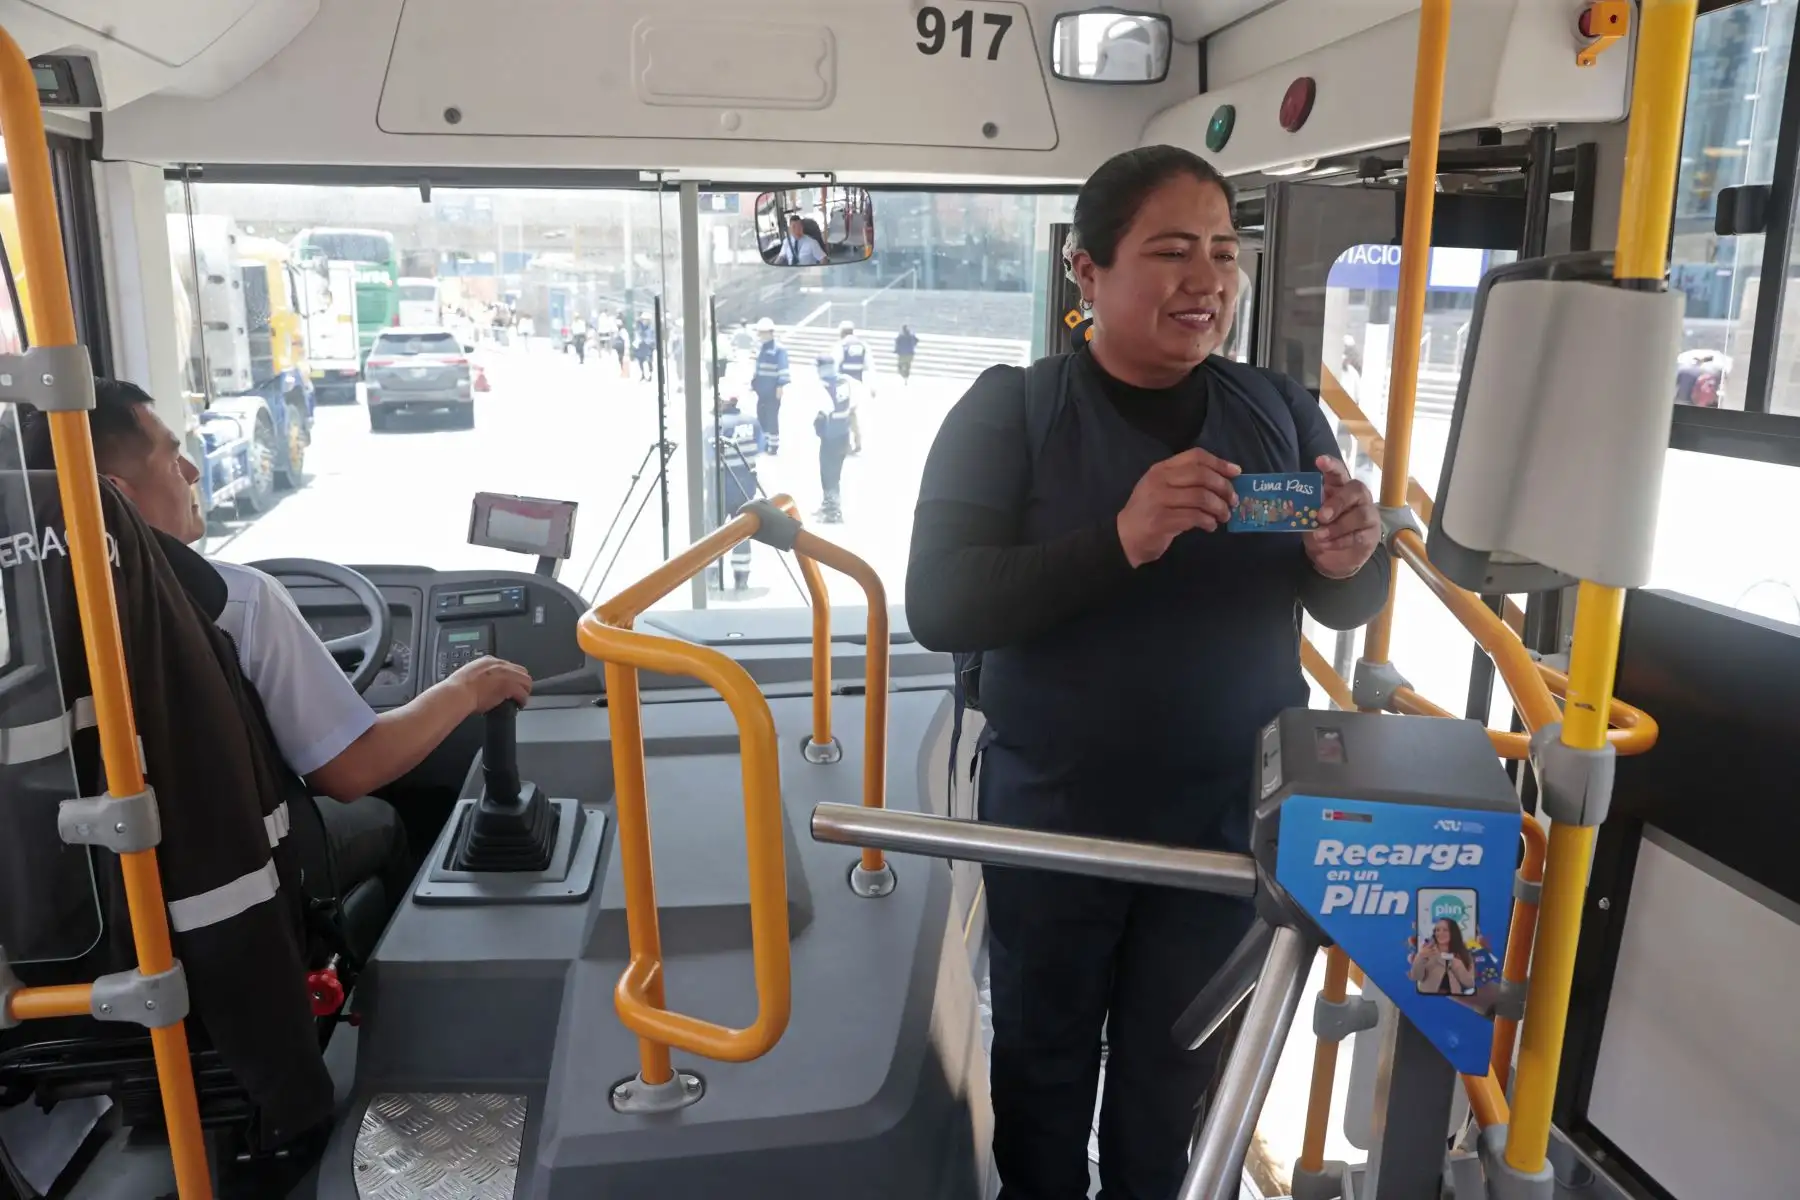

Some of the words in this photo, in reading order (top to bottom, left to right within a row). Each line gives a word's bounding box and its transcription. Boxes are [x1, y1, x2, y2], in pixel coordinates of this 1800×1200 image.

[916, 6, 1013, 61] 917
[1253, 479, 1282, 492] Lima
[1286, 479, 1315, 495] Pass
[1314, 839, 1484, 871] Recarga
[1327, 870, 1351, 881] en
[1354, 870, 1379, 881] un
[1320, 883, 1410, 915] Plin
[1435, 903, 1462, 917] plin
